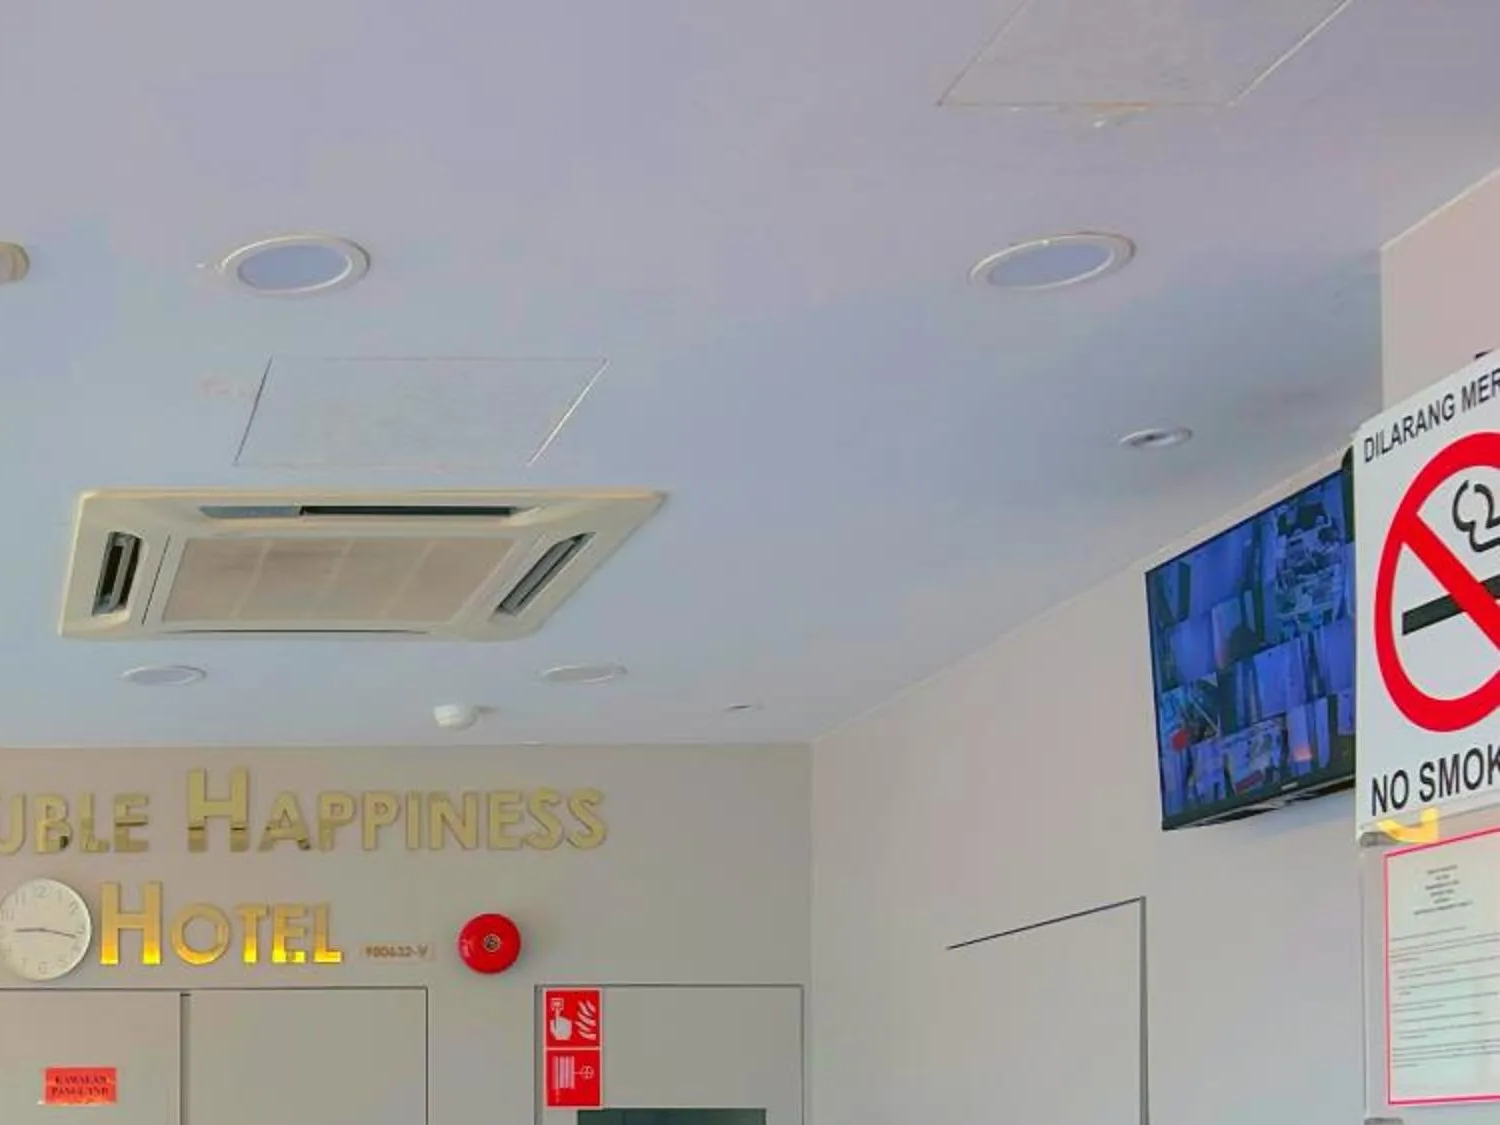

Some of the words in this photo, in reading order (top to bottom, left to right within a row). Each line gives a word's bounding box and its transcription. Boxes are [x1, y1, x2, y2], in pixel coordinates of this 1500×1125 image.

[1363, 393, 1455, 463] DILARANG
[186, 765, 608, 854] HAPPINESS
[1371, 768, 1409, 817] NO
[100, 881, 344, 967] HOTEL
